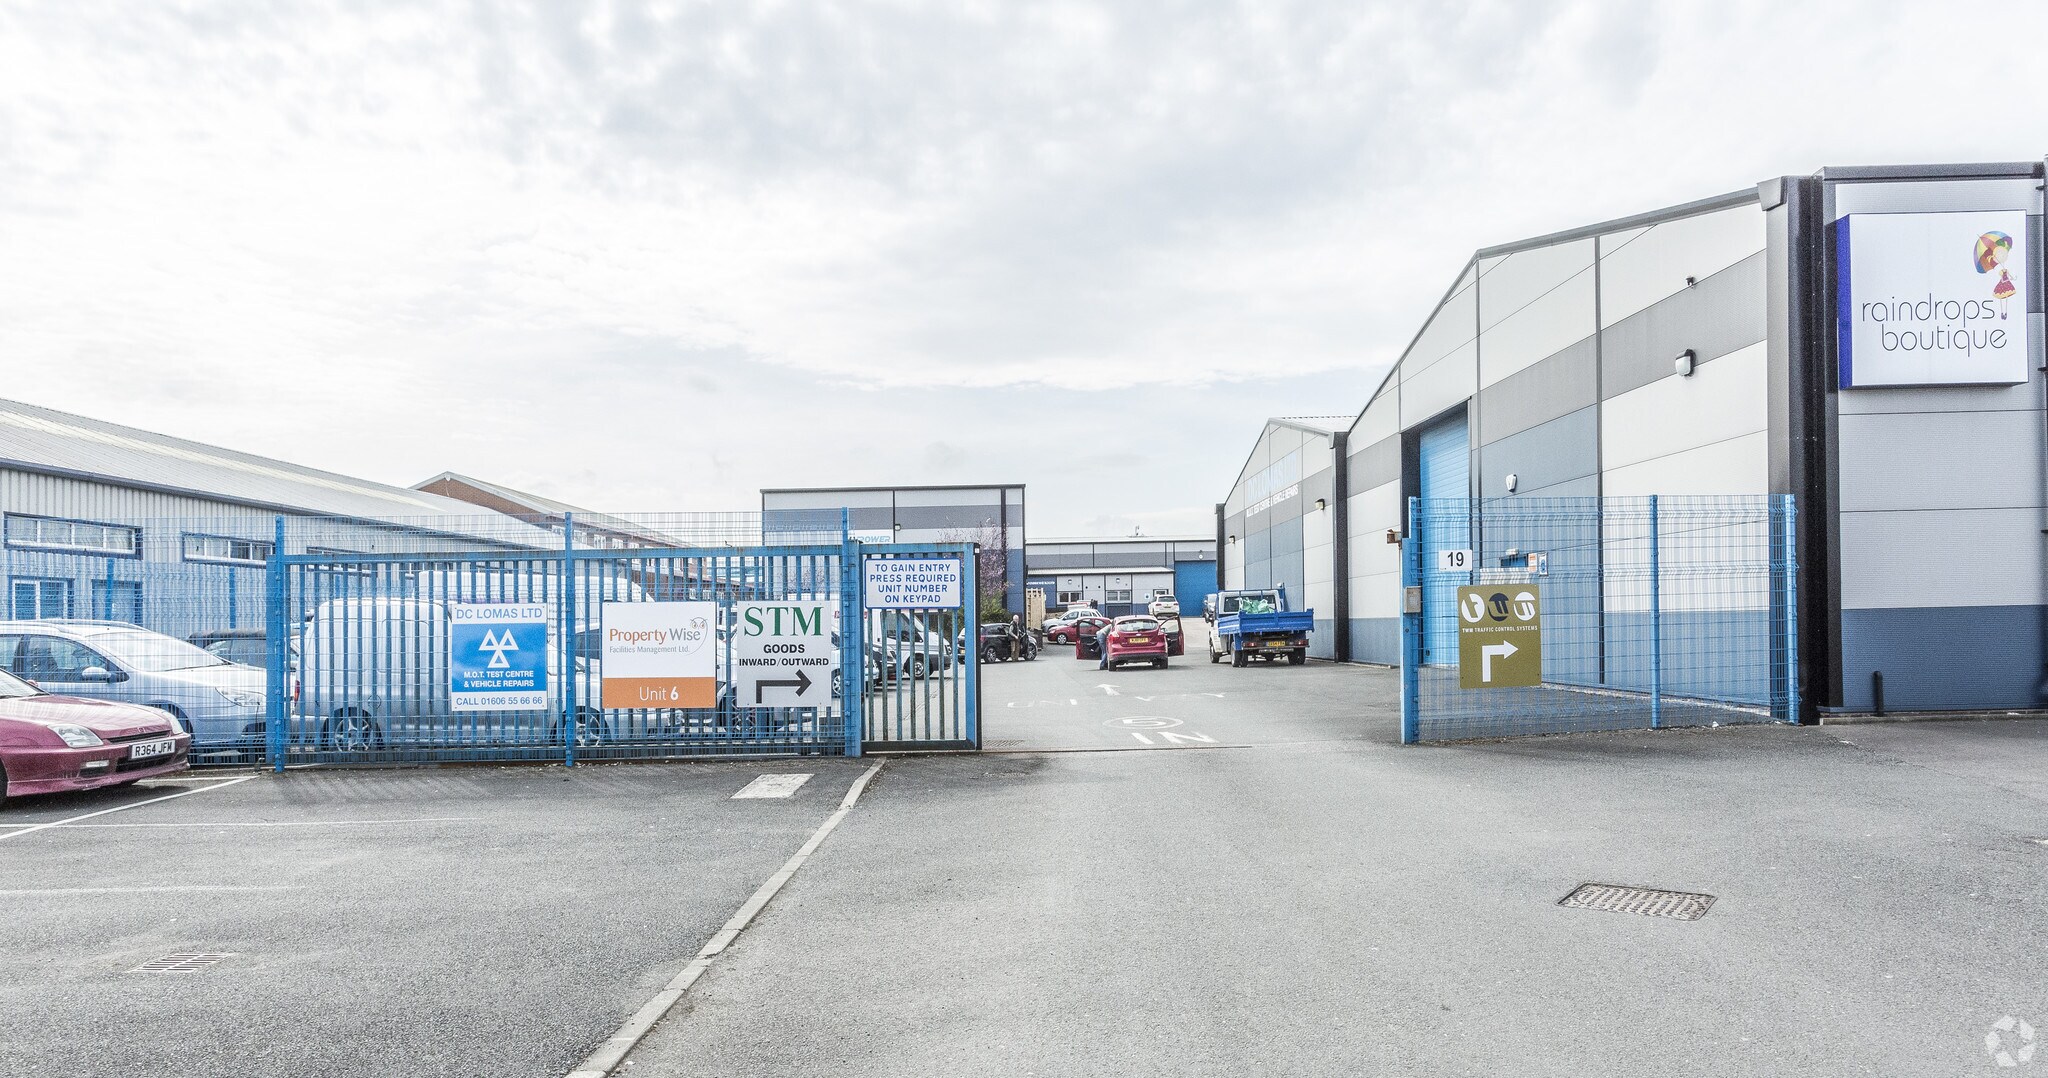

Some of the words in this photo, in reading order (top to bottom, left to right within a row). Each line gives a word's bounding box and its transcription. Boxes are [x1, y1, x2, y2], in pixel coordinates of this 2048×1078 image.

[1862, 292, 1995, 328] raindrops
[1881, 323, 2007, 357] boutique
[1447, 551, 1464, 567] 19
[875, 563, 888, 572] TO
[890, 563, 915, 572] GAIN
[918, 563, 951, 572] ENTRY
[869, 574, 902, 582] PRESS
[905, 574, 956, 582] REQUIRED
[878, 584, 901, 593] UNIT
[905, 584, 948, 593] NUMBER
[884, 594, 899, 603] ON
[903, 594, 941, 603] KEYPAD
[456, 609, 473, 619] DC
[476, 608, 518, 619] LOMAS
[521, 607, 543, 618] LTD
[743, 606, 825, 637] STM
[609, 628, 667, 645] Property
[669, 627, 701, 641] Wise
[609, 645, 636, 653] Facilities
[637, 645, 677, 655] Management
[763, 644, 805, 654] GOODS
[739, 658, 829, 667] INWARD/OUTWARD
[486, 670, 504, 678] TEST
[505, 670, 534, 678] CENTRE
[463, 680, 469, 688] &
[470, 680, 502, 688] VEHICLE
[503, 679, 535, 687] REPAIRS
[639, 686, 667, 701] Unit
[670, 686, 679, 701] 6
[456, 697, 479, 705] CALL
[481, 697, 506, 705] 01606
[507, 697, 518, 705] 55
[520, 696, 531, 705] 66
[532, 696, 543, 704] 66
[1131, 730, 1219, 744] IN
[135, 744, 156, 757] R364
